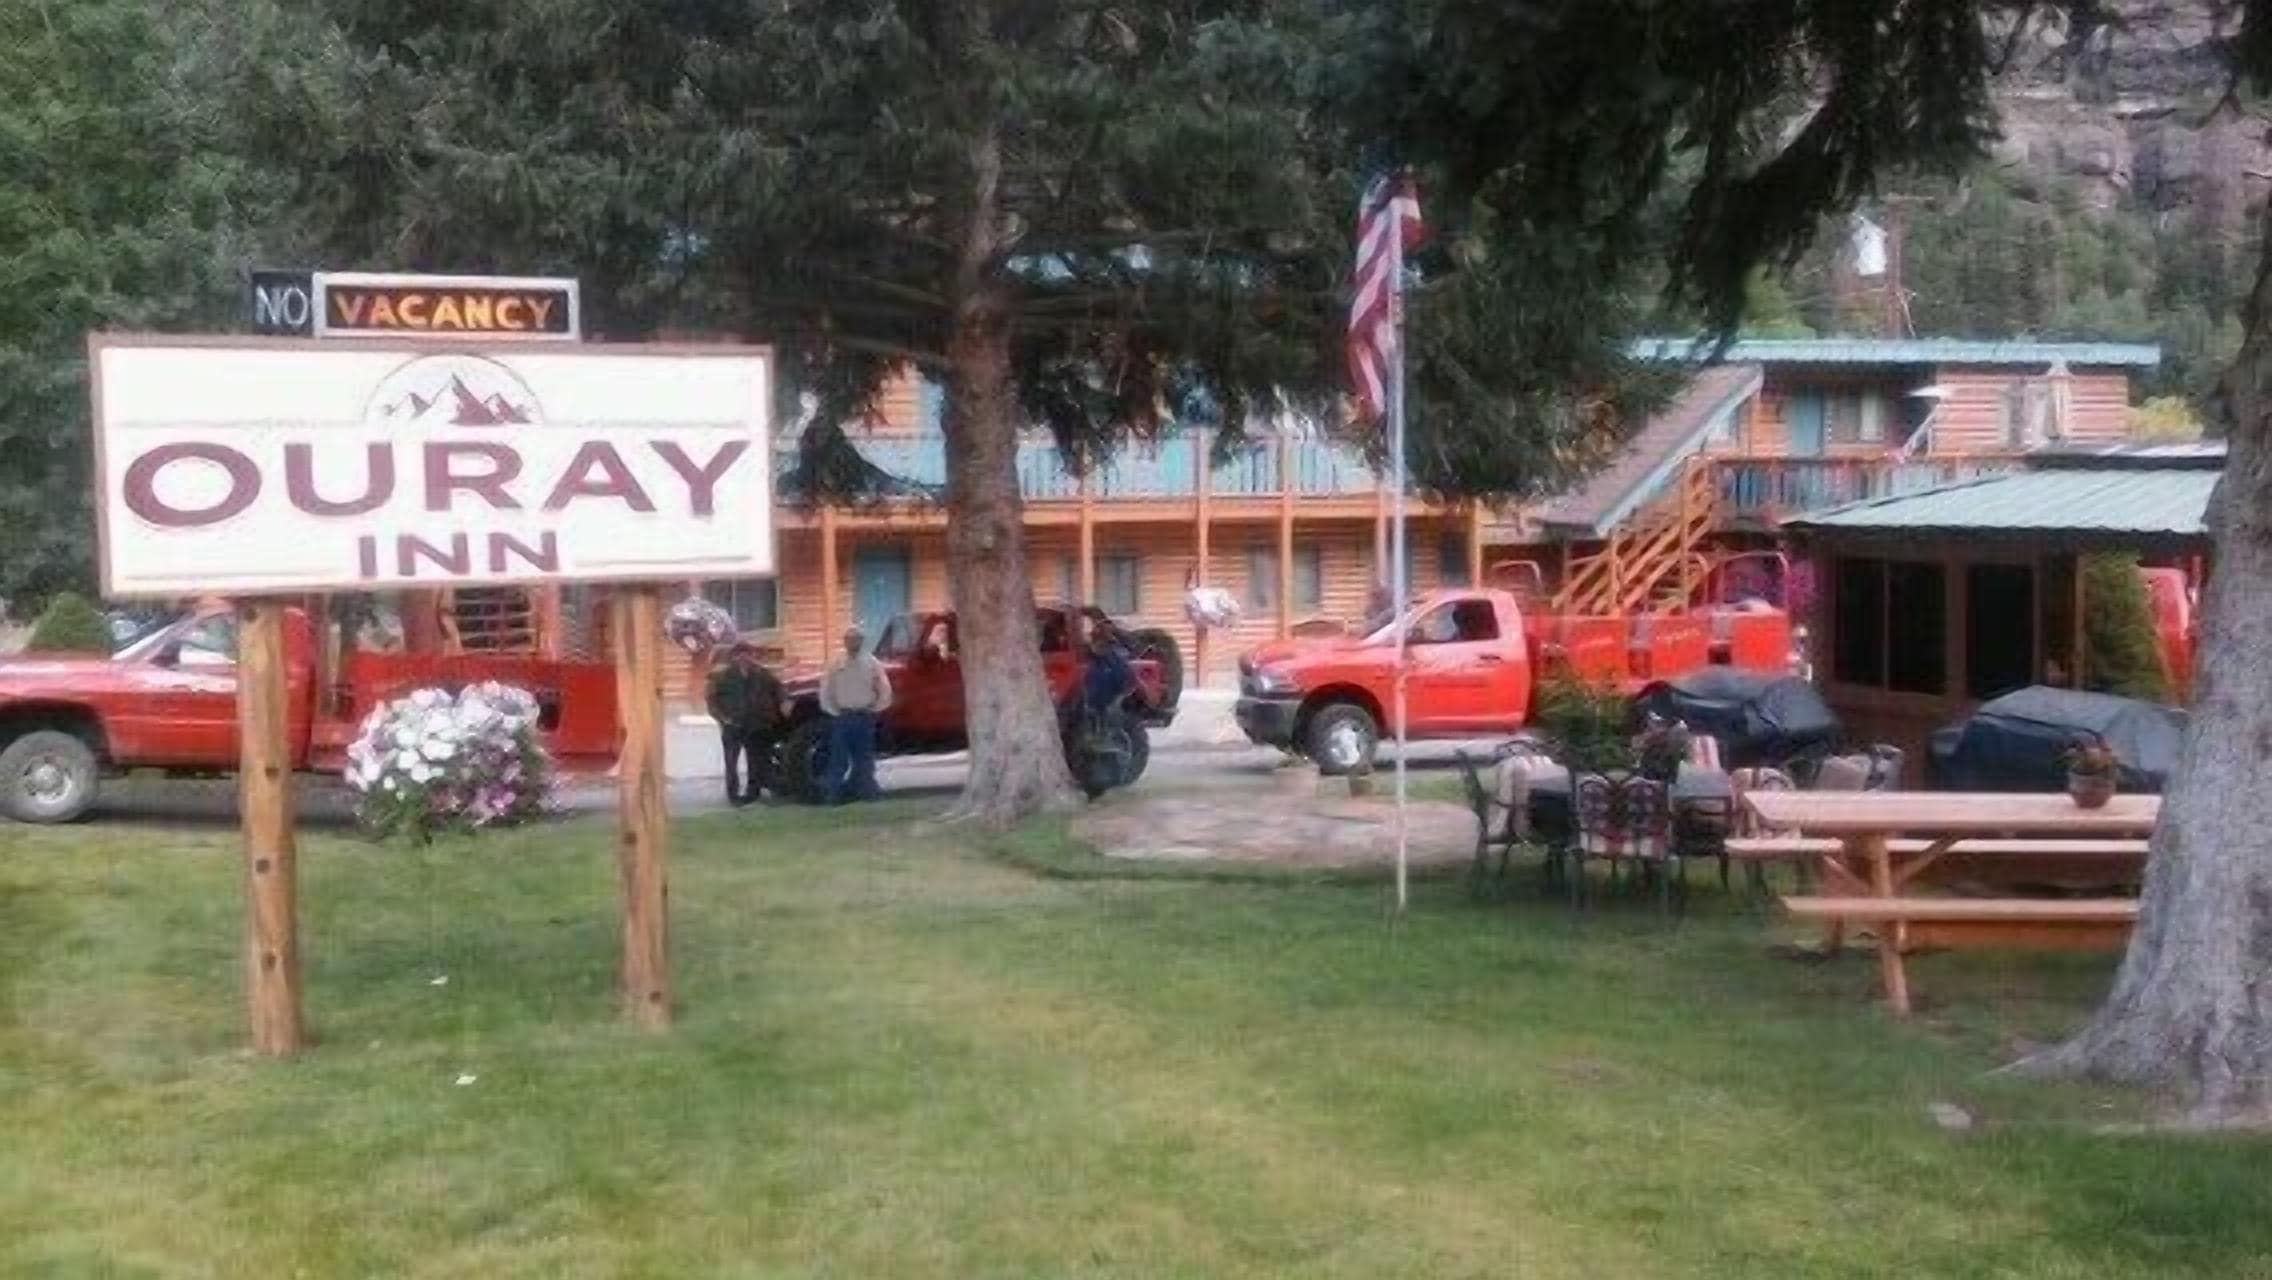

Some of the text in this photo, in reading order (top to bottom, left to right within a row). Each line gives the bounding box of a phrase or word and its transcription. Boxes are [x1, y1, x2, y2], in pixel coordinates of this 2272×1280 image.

[255, 284, 552, 330] NO VACANCY
[123, 440, 750, 527] OURAY
[358, 530, 559, 577] INN
